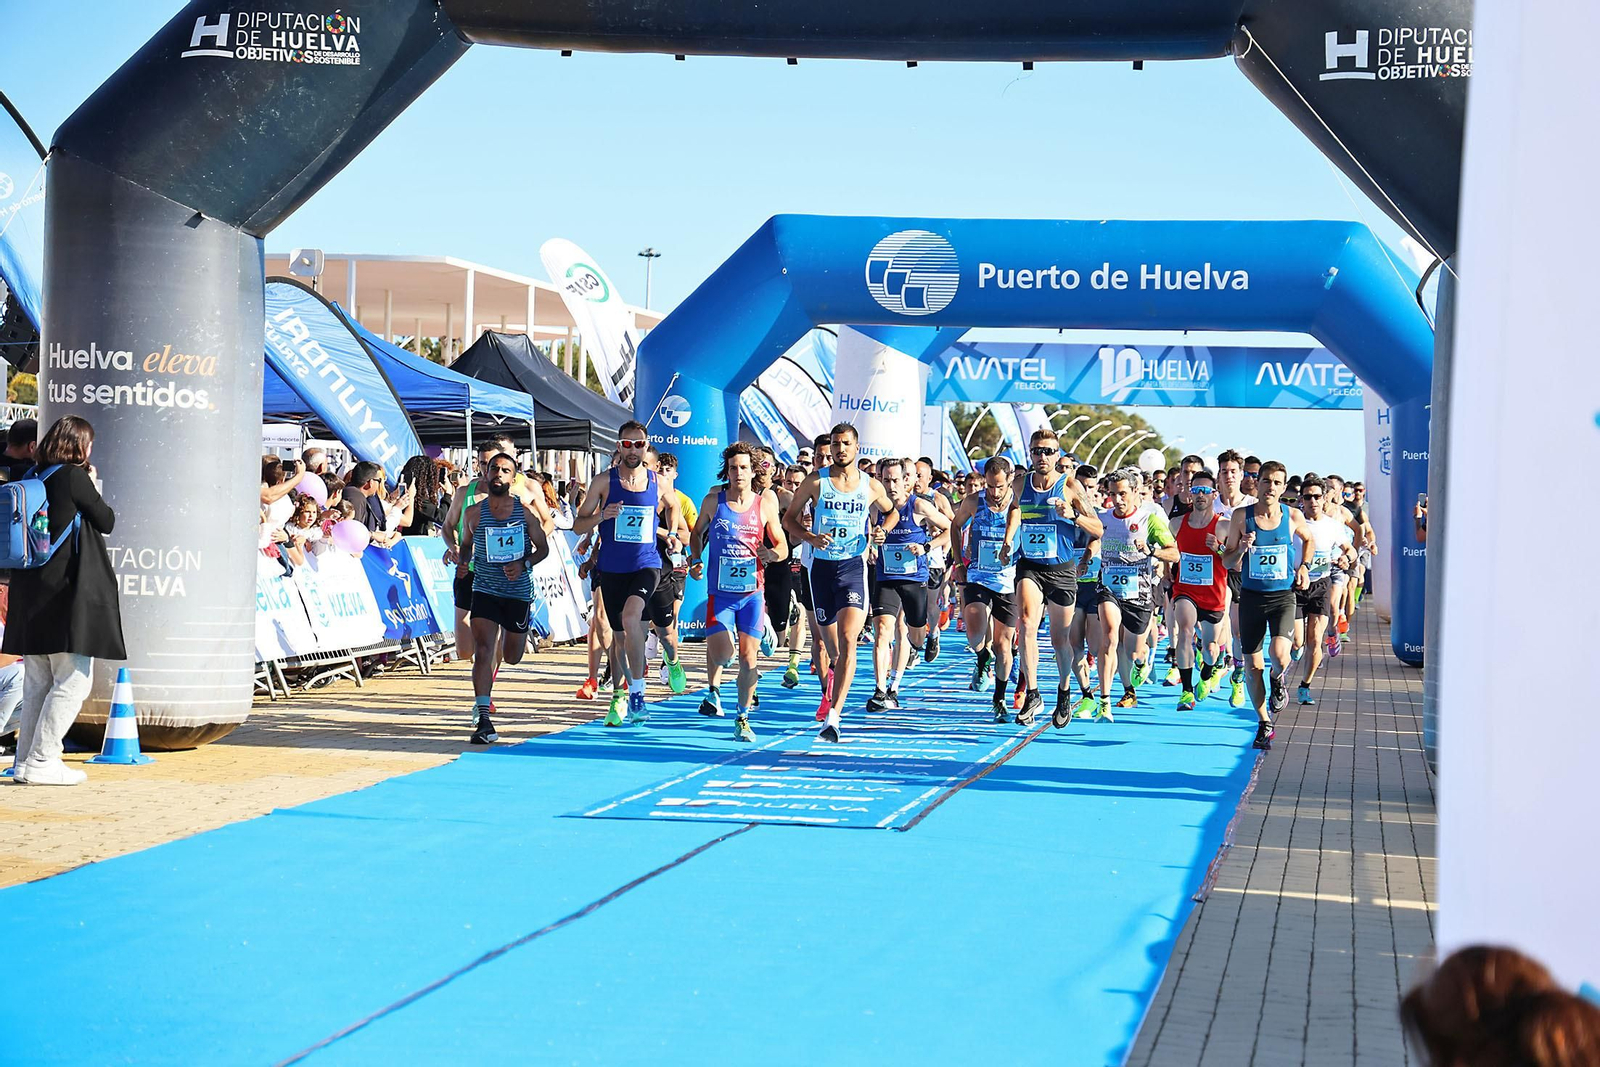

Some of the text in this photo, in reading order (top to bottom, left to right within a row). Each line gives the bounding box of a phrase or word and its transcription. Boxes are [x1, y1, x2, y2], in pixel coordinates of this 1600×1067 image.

[237, 9, 361, 34] DIPUTACIÓN
[236, 30, 361, 51] DE HUELVA
[1378, 28, 1473, 46] DIPUTACI
[235, 47, 314, 64] OBJETIVOS
[314, 56, 361, 66] SOSTENIBLE
[1378, 46, 1475, 66] DE HUEL
[1378, 63, 1461, 80] OBJETIVOS
[978, 262, 1249, 290] Puerto de Huelva
[48, 342, 217, 376] Huelva eleva
[944, 356, 1056, 381] AVATEL
[1141, 359, 1210, 381] HUELVA
[47, 379, 77, 403] tus
[1014, 381, 1056, 391] TELECOM
[1328, 387, 1363, 396] TELECO
[838, 393, 900, 414] Huelva
[645, 434, 718, 446] erto de Huelva
[824, 499, 864, 514] nerja
[626, 515, 645, 527] 27
[829, 527, 848, 538] 18
[1029, 533, 1046, 544] 22
[497, 535, 515, 548] 14
[894, 551, 903, 562] 9
[1403, 546, 1427, 557] Puert
[105, 545, 202, 572] TACIÓN
[1259, 554, 1277, 566] 20
[730, 567, 748, 578] 25
[1188, 562, 1203, 573] 35
[118, 574, 187, 597] ELVA
[1111, 574, 1129, 586] 26
[676, 619, 707, 630] Huelv
[1404, 642, 1425, 653] Puer
[777, 783, 902, 793] HUELVA
[737, 801, 869, 813] HUELVA
